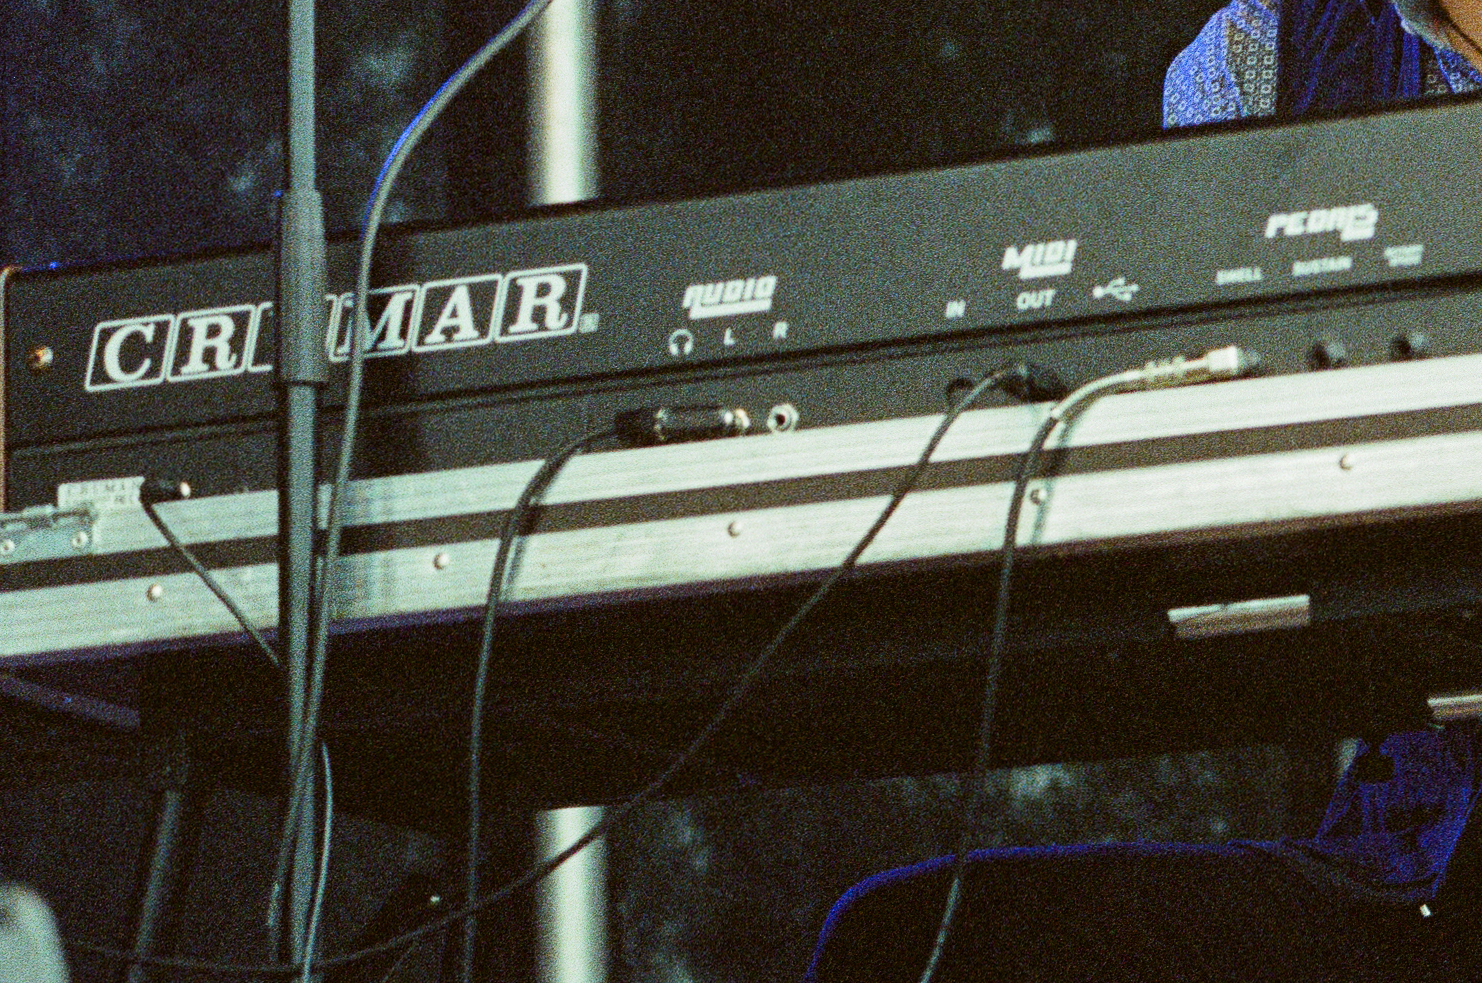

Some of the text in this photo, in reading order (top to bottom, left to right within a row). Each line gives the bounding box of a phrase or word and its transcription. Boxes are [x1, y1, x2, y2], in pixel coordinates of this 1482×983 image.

[1002, 239, 1077, 279] MIDI
[682, 275, 777, 320] AUDIO
[945, 299, 967, 318] IN
[1017, 288, 1056, 311] OUT
[103, 272, 568, 384] CRMAR
[723, 327, 735, 346] L
[773, 321, 788, 339] R
